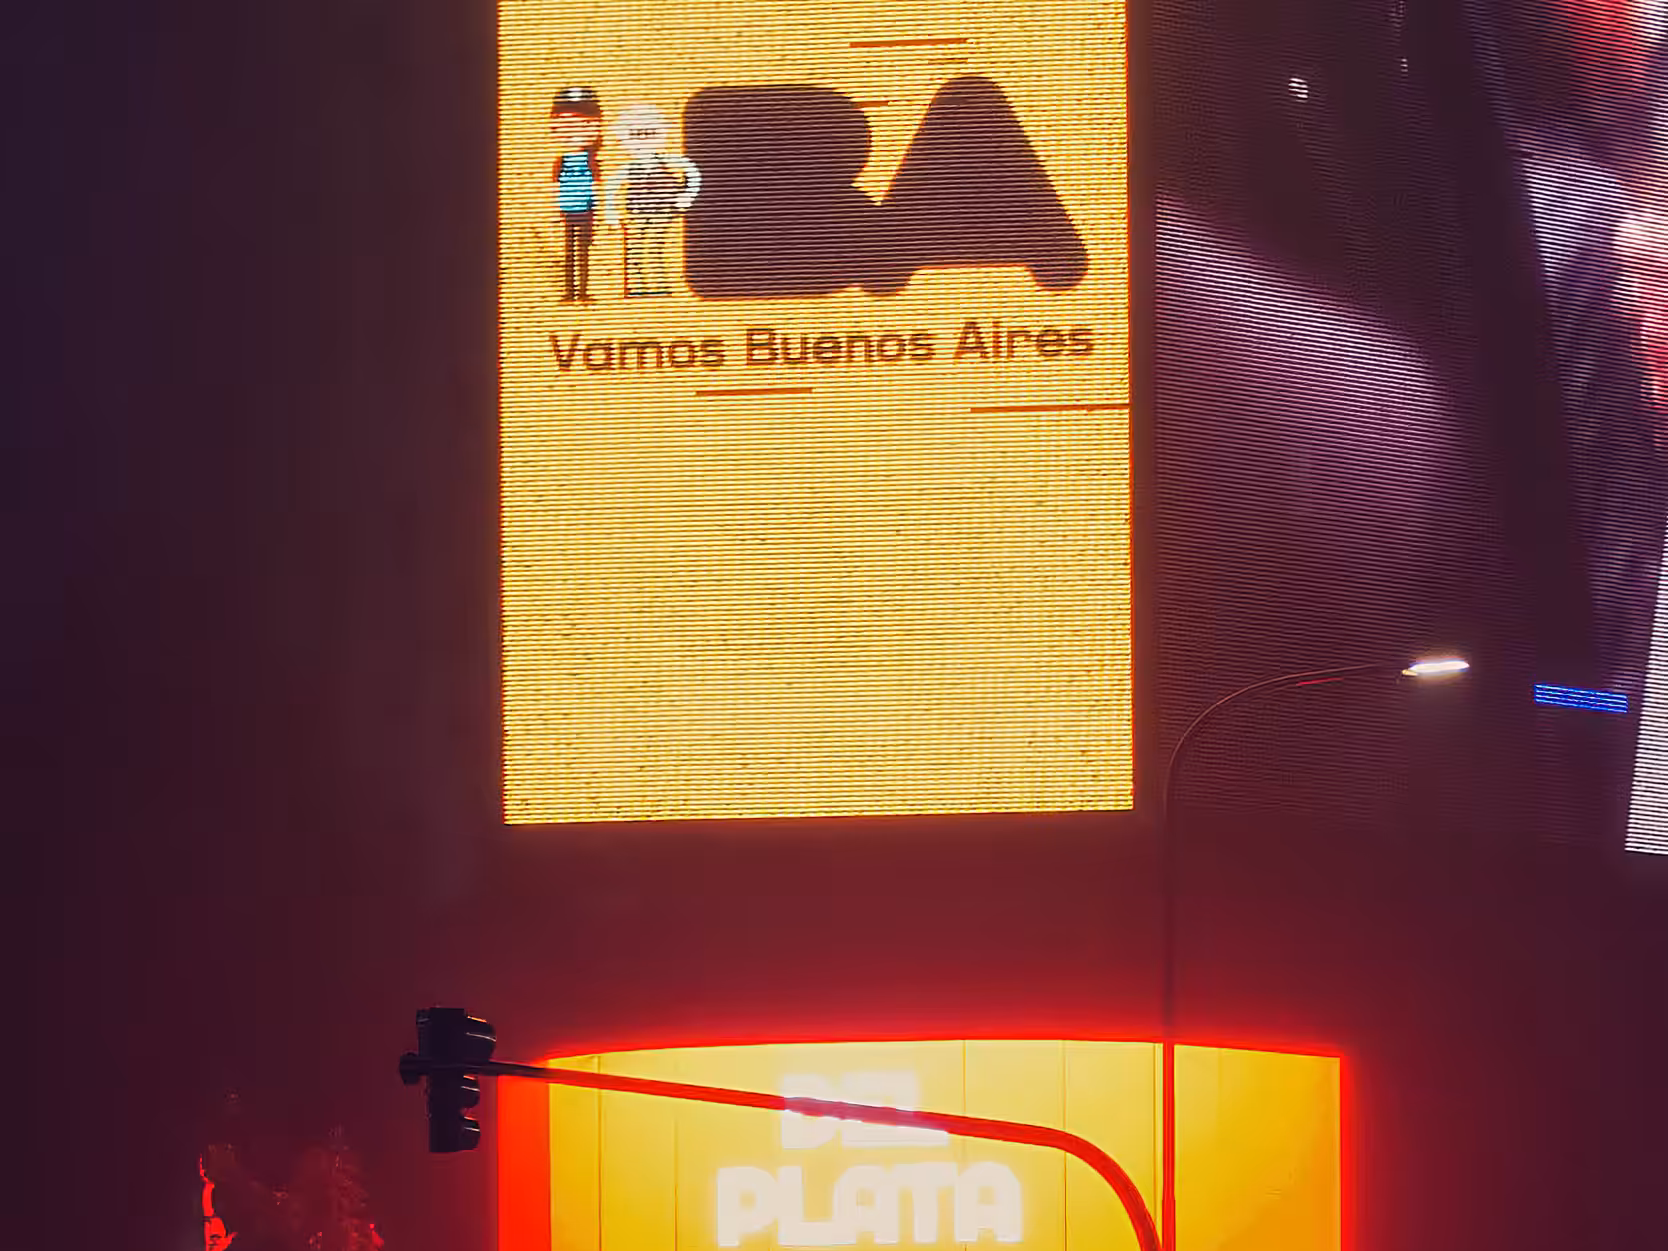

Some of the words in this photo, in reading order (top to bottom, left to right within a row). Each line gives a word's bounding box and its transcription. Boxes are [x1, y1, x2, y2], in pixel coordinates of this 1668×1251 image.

[549, 330, 725, 374] Vamos
[745, 326, 935, 368] Buenos
[952, 319, 1095, 364] Aires
[781, 1071, 949, 1149] DEL
[716, 1160, 1024, 1248] PLATA
